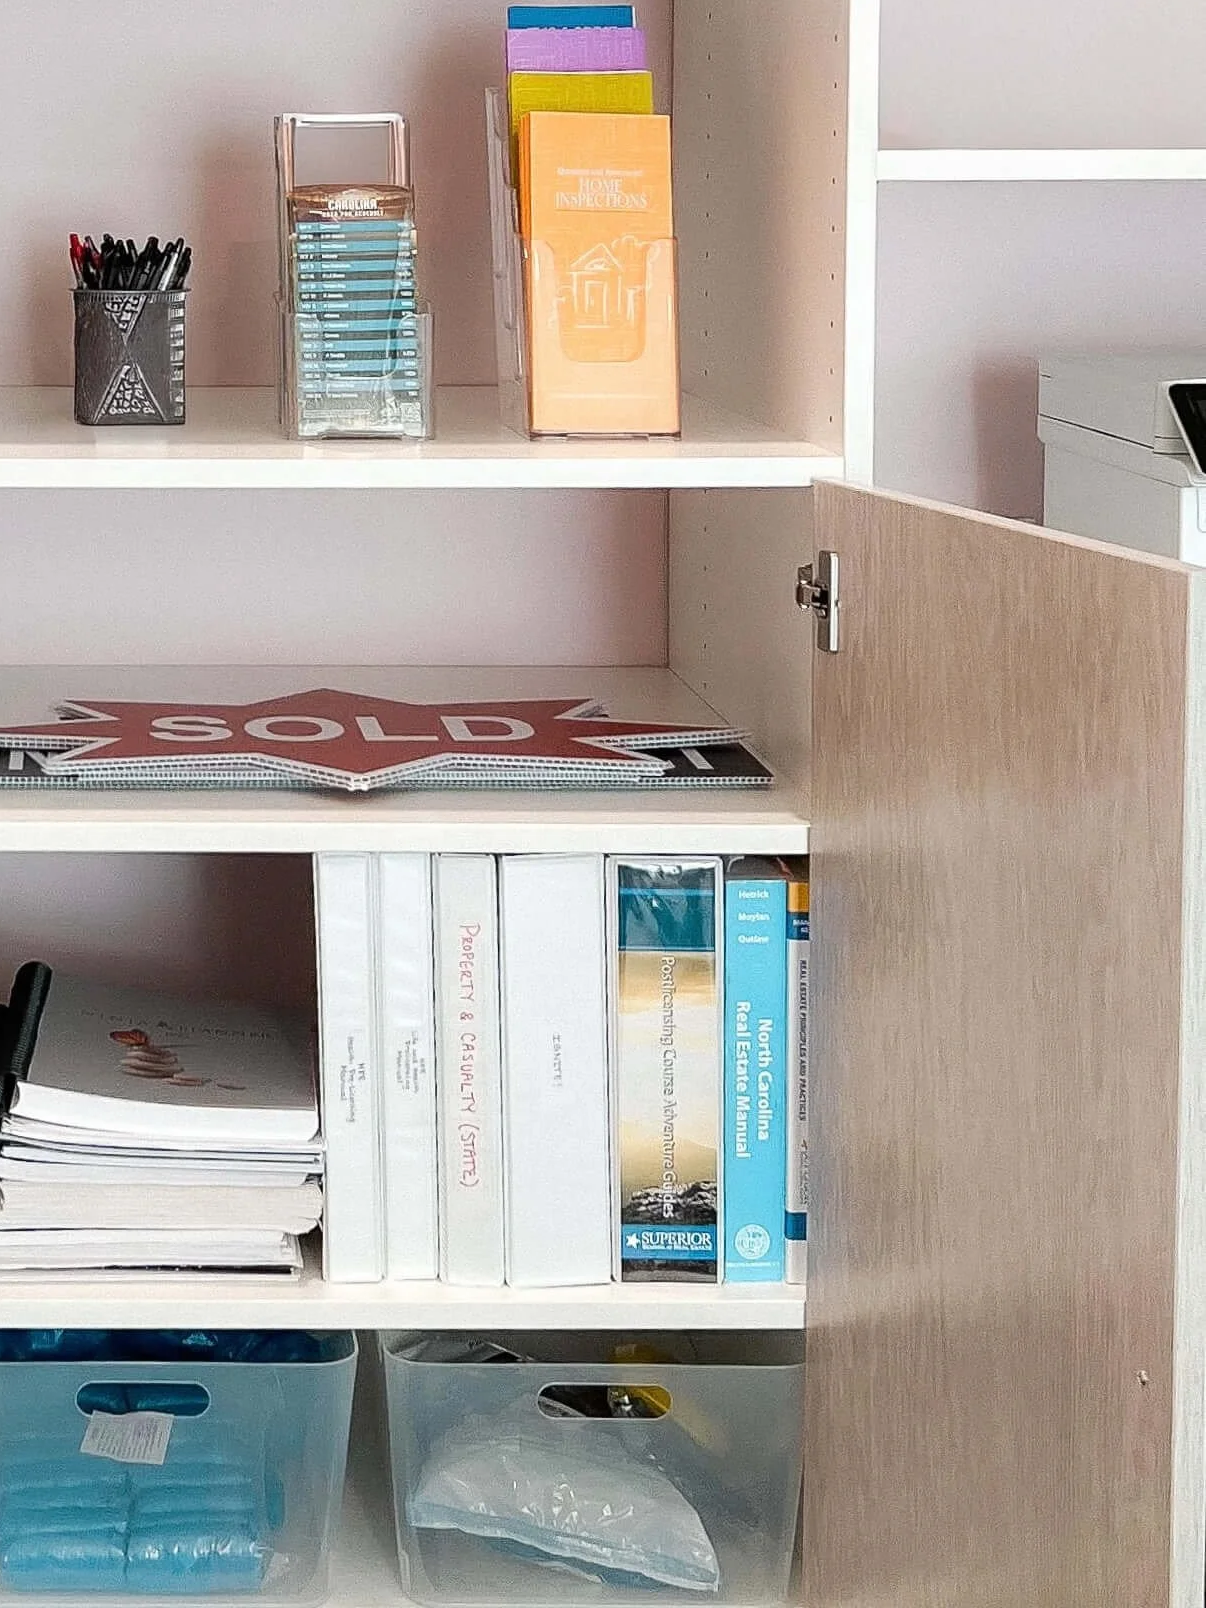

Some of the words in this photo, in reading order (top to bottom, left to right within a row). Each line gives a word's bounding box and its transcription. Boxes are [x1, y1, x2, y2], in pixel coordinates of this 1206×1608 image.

[555, 191, 648, 209] INSPECTIONS
[578, 177, 623, 193] HOME
[149, 714, 536, 743] SOLD
[738, 889, 770, 899] Hetrick
[459, 922, 482, 1002] PROPERTY
[799, 959, 808, 980] REAL
[460, 1011, 475, 1021] &
[660, 956, 676, 1046] Postlicensing
[799, 982, 808, 1010] ESTATE
[736, 1001, 751, 1037] Real
[799, 1012, 808, 1057] PRINCIPLES
[758, 1018, 773, 1067] North
[460, 1032, 477, 1114] CASUALTY
[662, 1048, 676, 1096] Course
[736, 1040, 751, 1092] Estate
[799, 1059, 808, 1077] AND
[758, 1070, 773, 1140] Carolina
[799, 1078, 808, 1121] PRACTICES
[736, 1095, 751, 1158] Manual
[457, 1123, 481, 1188] (STATE)
[662, 1171, 677, 1218] Guides
[642, 1232, 712, 1245] SUPERIOR
